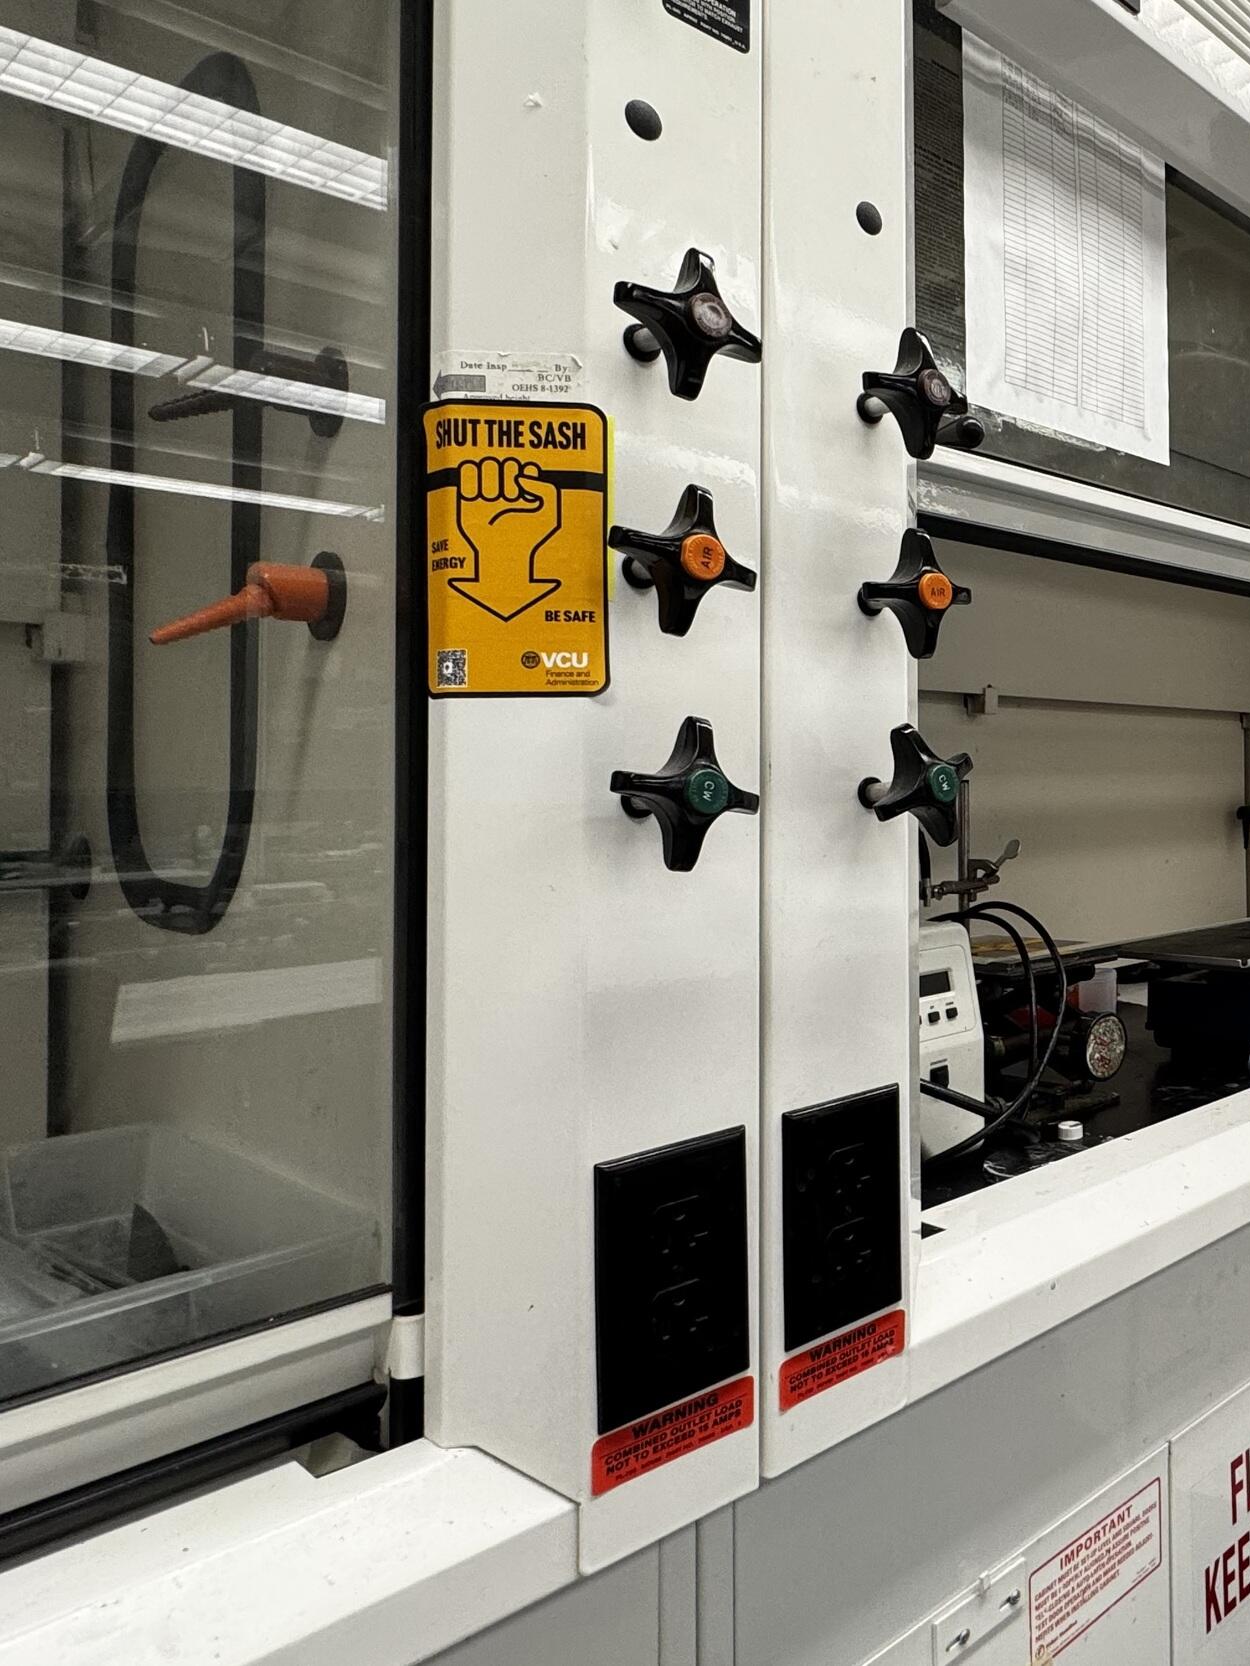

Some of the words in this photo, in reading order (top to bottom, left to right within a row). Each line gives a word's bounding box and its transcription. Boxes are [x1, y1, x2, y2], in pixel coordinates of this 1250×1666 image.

[460, 361, 483, 370] Date
[486, 361, 508, 373] Insp
[554, 364, 568, 374] By
[537, 373, 572, 383] BC/VB
[511, 383, 539, 392] OEHS
[540, 384, 570, 393] 8-1392
[436, 418, 481, 449] SHUT
[484, 419, 525, 448] THE
[528, 420, 586, 450] SASH
[432, 539, 449, 554] SAVE
[432, 556, 467, 572] ENERGY
[701, 546, 714, 569] AIR
[930, 587, 946, 597] AIR
[544, 610, 561, 622] BE
[563, 610, 596, 623] SAFE
[540, 651, 589, 669] VCU
[545, 669, 575, 678] Finance
[576, 669, 591, 678] and
[545, 678, 600, 687] Administration
[702, 780, 715, 802] CW
[938, 774, 951, 791] CW
[808, 1323, 877, 1362] WARNING
[789, 1360, 838, 1385] COMBINED
[839, 1340, 872, 1362] OUTLET
[872, 1329, 895, 1345] LOAD
[790, 1380, 808, 1394] NOT
[811, 1372, 823, 1384] TO
[825, 1355, 859, 1376] EXCEED
[870, 1338, 894, 1354] AMPS
[632, 1392, 719, 1439] WARNING
[604, 1432, 668, 1466] COMBINED
[671, 1412, 712, 1438] OUTLET
[714, 1400, 743, 1417] LOAD
[606, 1459, 630, 1475] NOT
[634, 1451, 649, 1463] TO
[652, 1430, 696, 1454] EXCEED
[698, 1421, 710, 1433] 15
[712, 1410, 742, 1427] AMPS
[1059, 1504, 1133, 1570] IMPORTANT
[1058, 1567, 1073, 1583] MUST
[1098, 1538, 1112, 1552] LEVEL
[1092, 1574, 1103, 1587] AND
